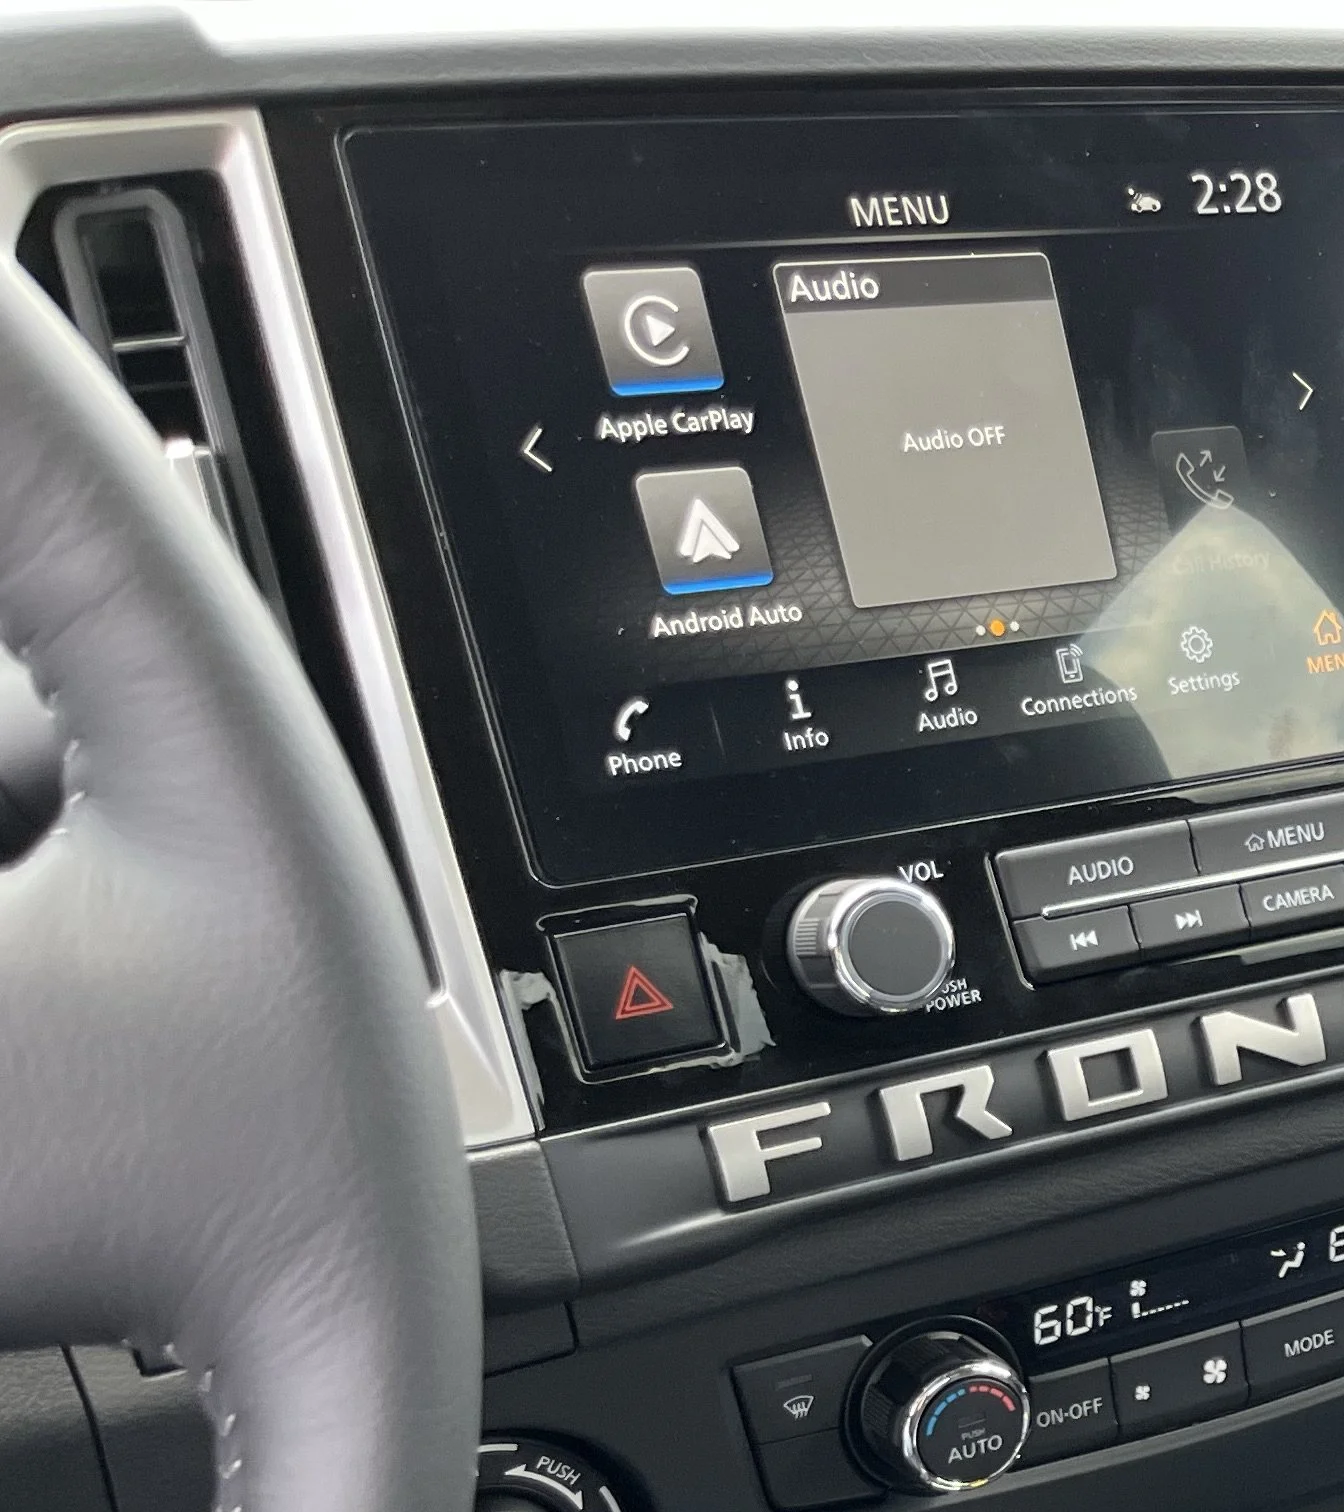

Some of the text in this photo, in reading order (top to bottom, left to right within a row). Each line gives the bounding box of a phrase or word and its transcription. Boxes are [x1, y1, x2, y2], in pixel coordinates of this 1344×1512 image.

[1191, 171, 1282, 217] 2:28
[850, 195, 949, 228] MENU
[790, 271, 880, 304] Audio
[600, 405, 755, 442] Apple CarPlay
[903, 425, 1005, 453] Audio OFF
[651, 602, 803, 639] Android Auto
[1168, 667, 1242, 695] Settings
[1021, 682, 1138, 717] Connections
[918, 704, 979, 732] Audio
[784, 724, 829, 752] Info
[608, 747, 682, 778] Phone
[1266, 820, 1325, 848] MENU
[898, 860, 944, 883] VOL
[1068, 856, 1134, 886] AUDIO
[1264, 884, 1334, 911] CAMERA
[1284, 1329, 1335, 1358] MODE
[1036, 1397, 1103, 1429] ON-OFF
[948, 1435, 1003, 1464] AUTO
[536, 1455, 582, 1486] PUSH
